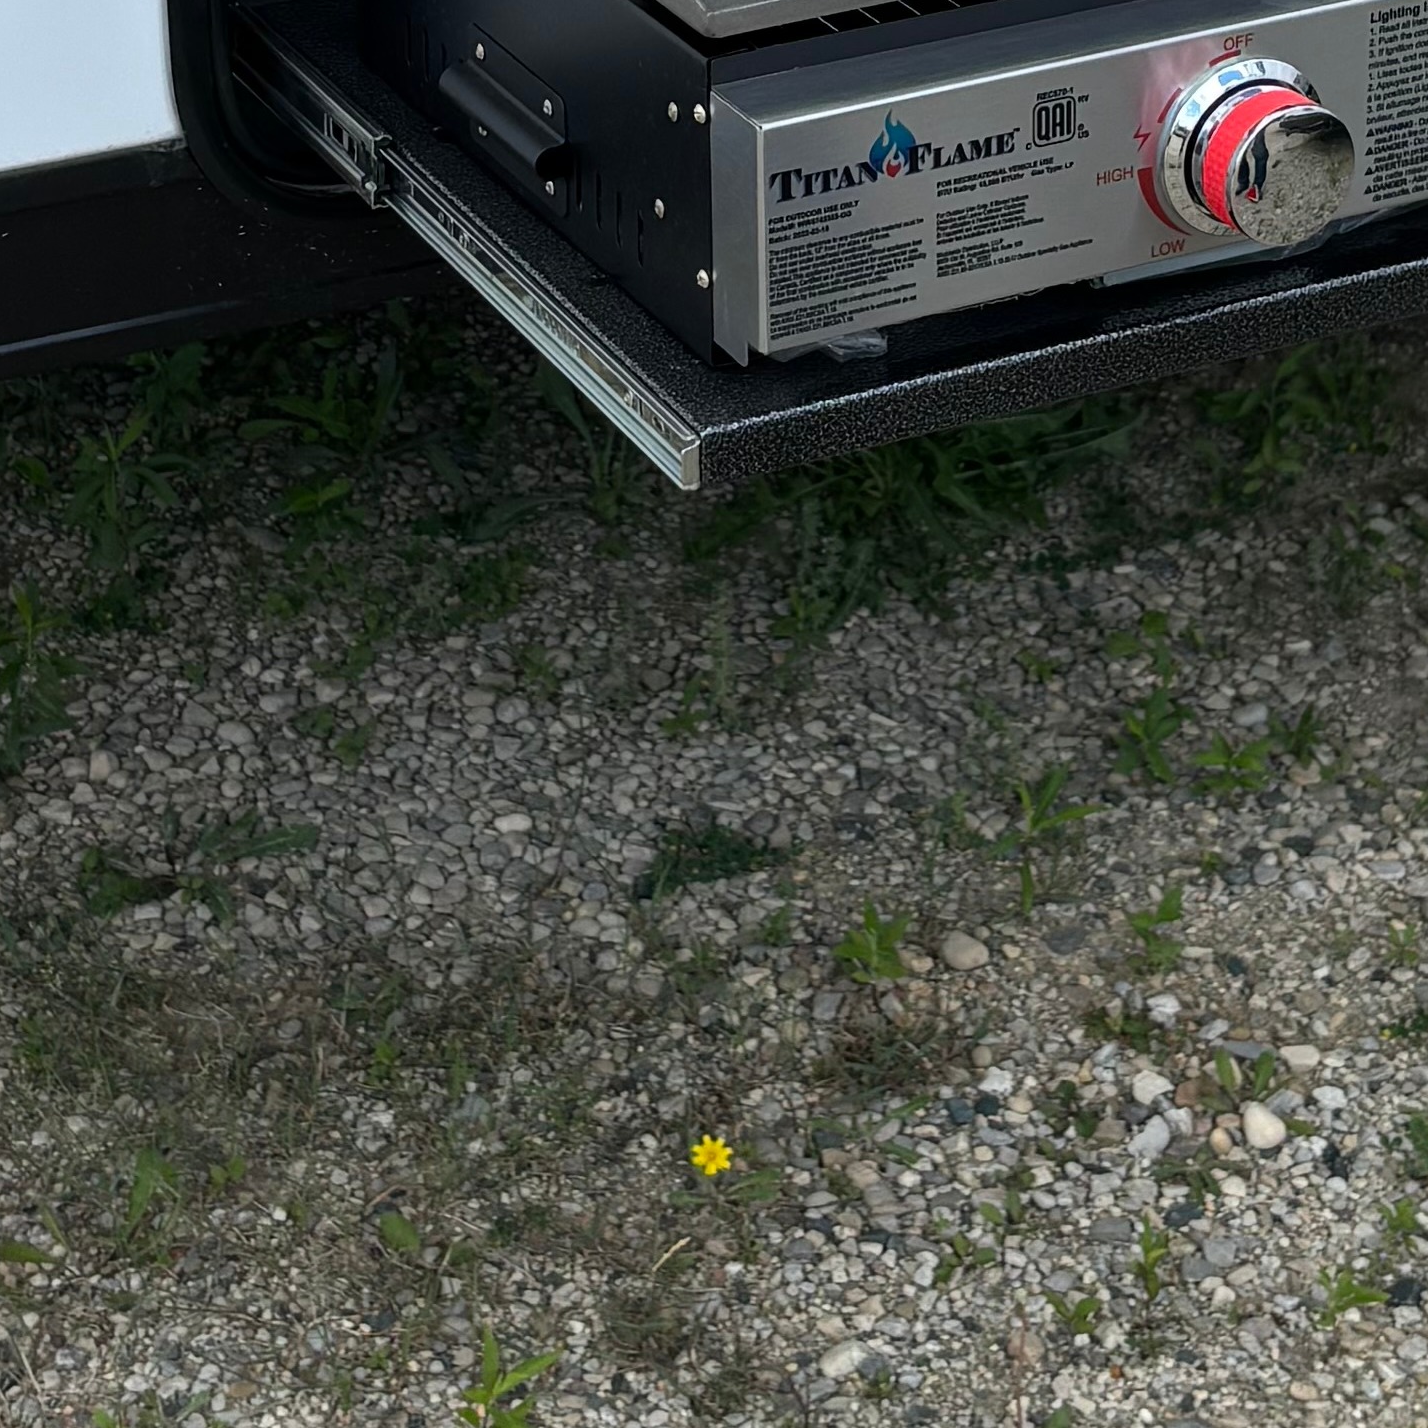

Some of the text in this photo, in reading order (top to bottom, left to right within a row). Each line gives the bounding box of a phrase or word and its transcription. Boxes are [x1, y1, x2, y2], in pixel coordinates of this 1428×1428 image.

[1370, 5, 1420, 23] Lighting
[1379, 22, 1399, 33] Read
[1223, 33, 1254, 50] OFF
[1378, 34, 1397, 44] Push
[1037, 100, 1071, 142] QAI
[769, 159, 878, 204] TITAN
[1096, 165, 1134, 186] HIGH
[1151, 239, 1186, 258] LOW
